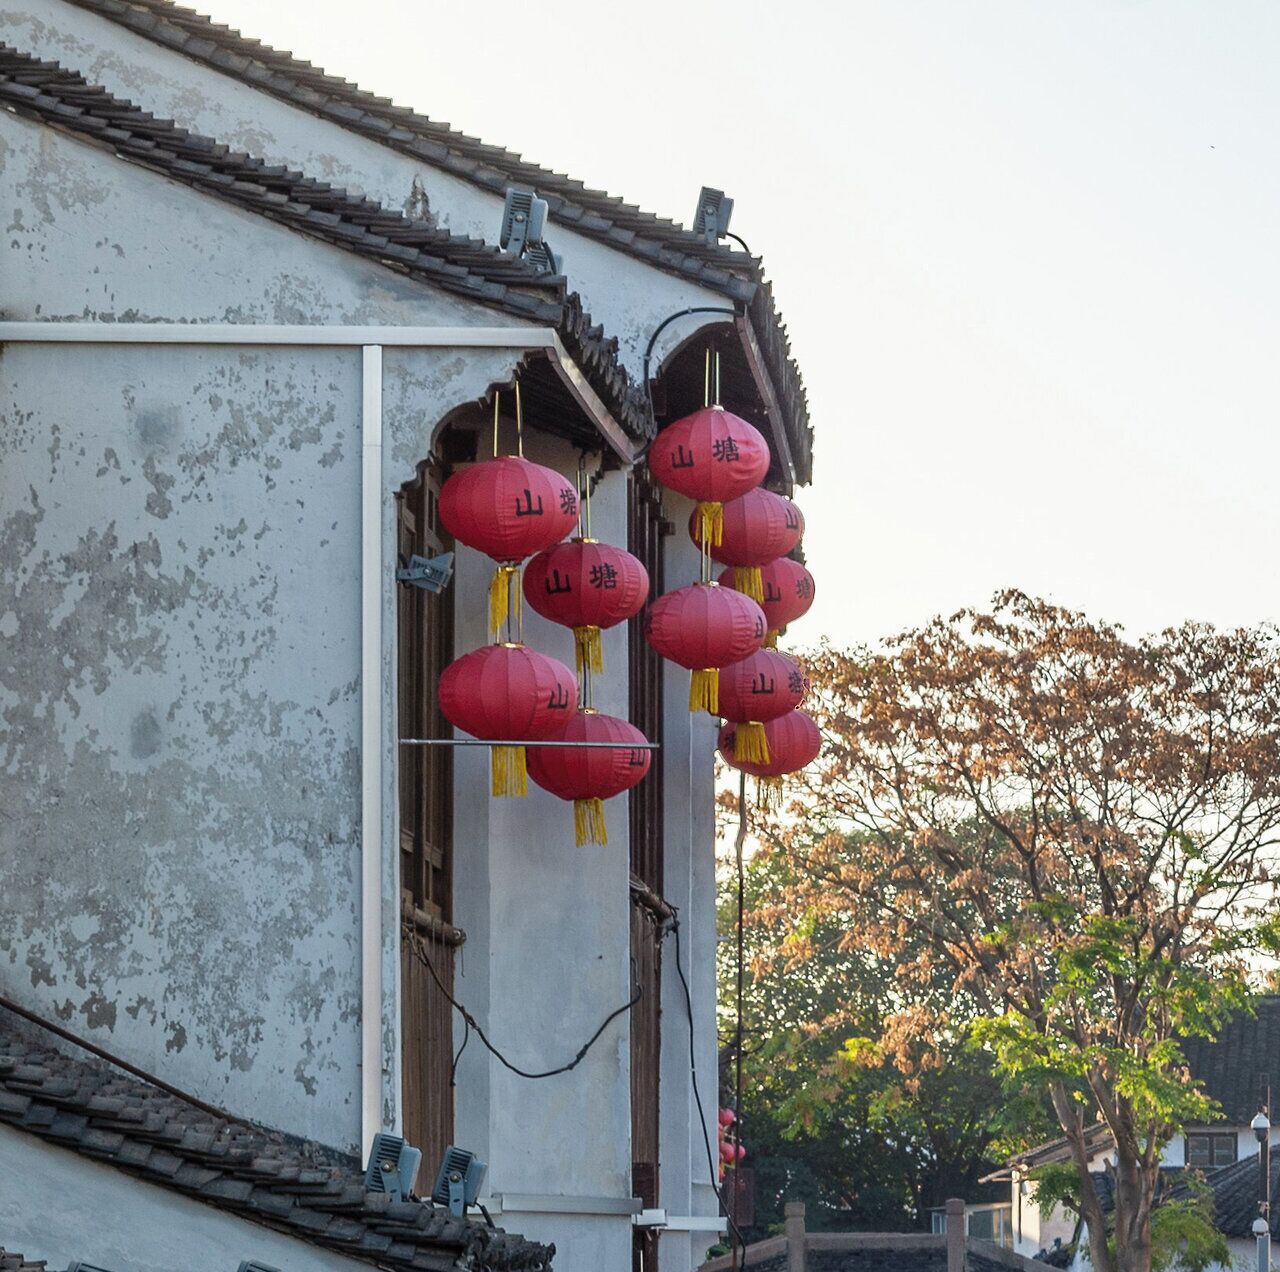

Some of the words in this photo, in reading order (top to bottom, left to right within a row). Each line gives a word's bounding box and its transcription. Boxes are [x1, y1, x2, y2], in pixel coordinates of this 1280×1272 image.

[671, 436, 739, 469] 山塘
[514, 487, 578, 517] 山塘
[784, 508, 799, 530] 山
[545, 562, 619, 594] 山塘
[752, 671, 804, 695] 山塘
